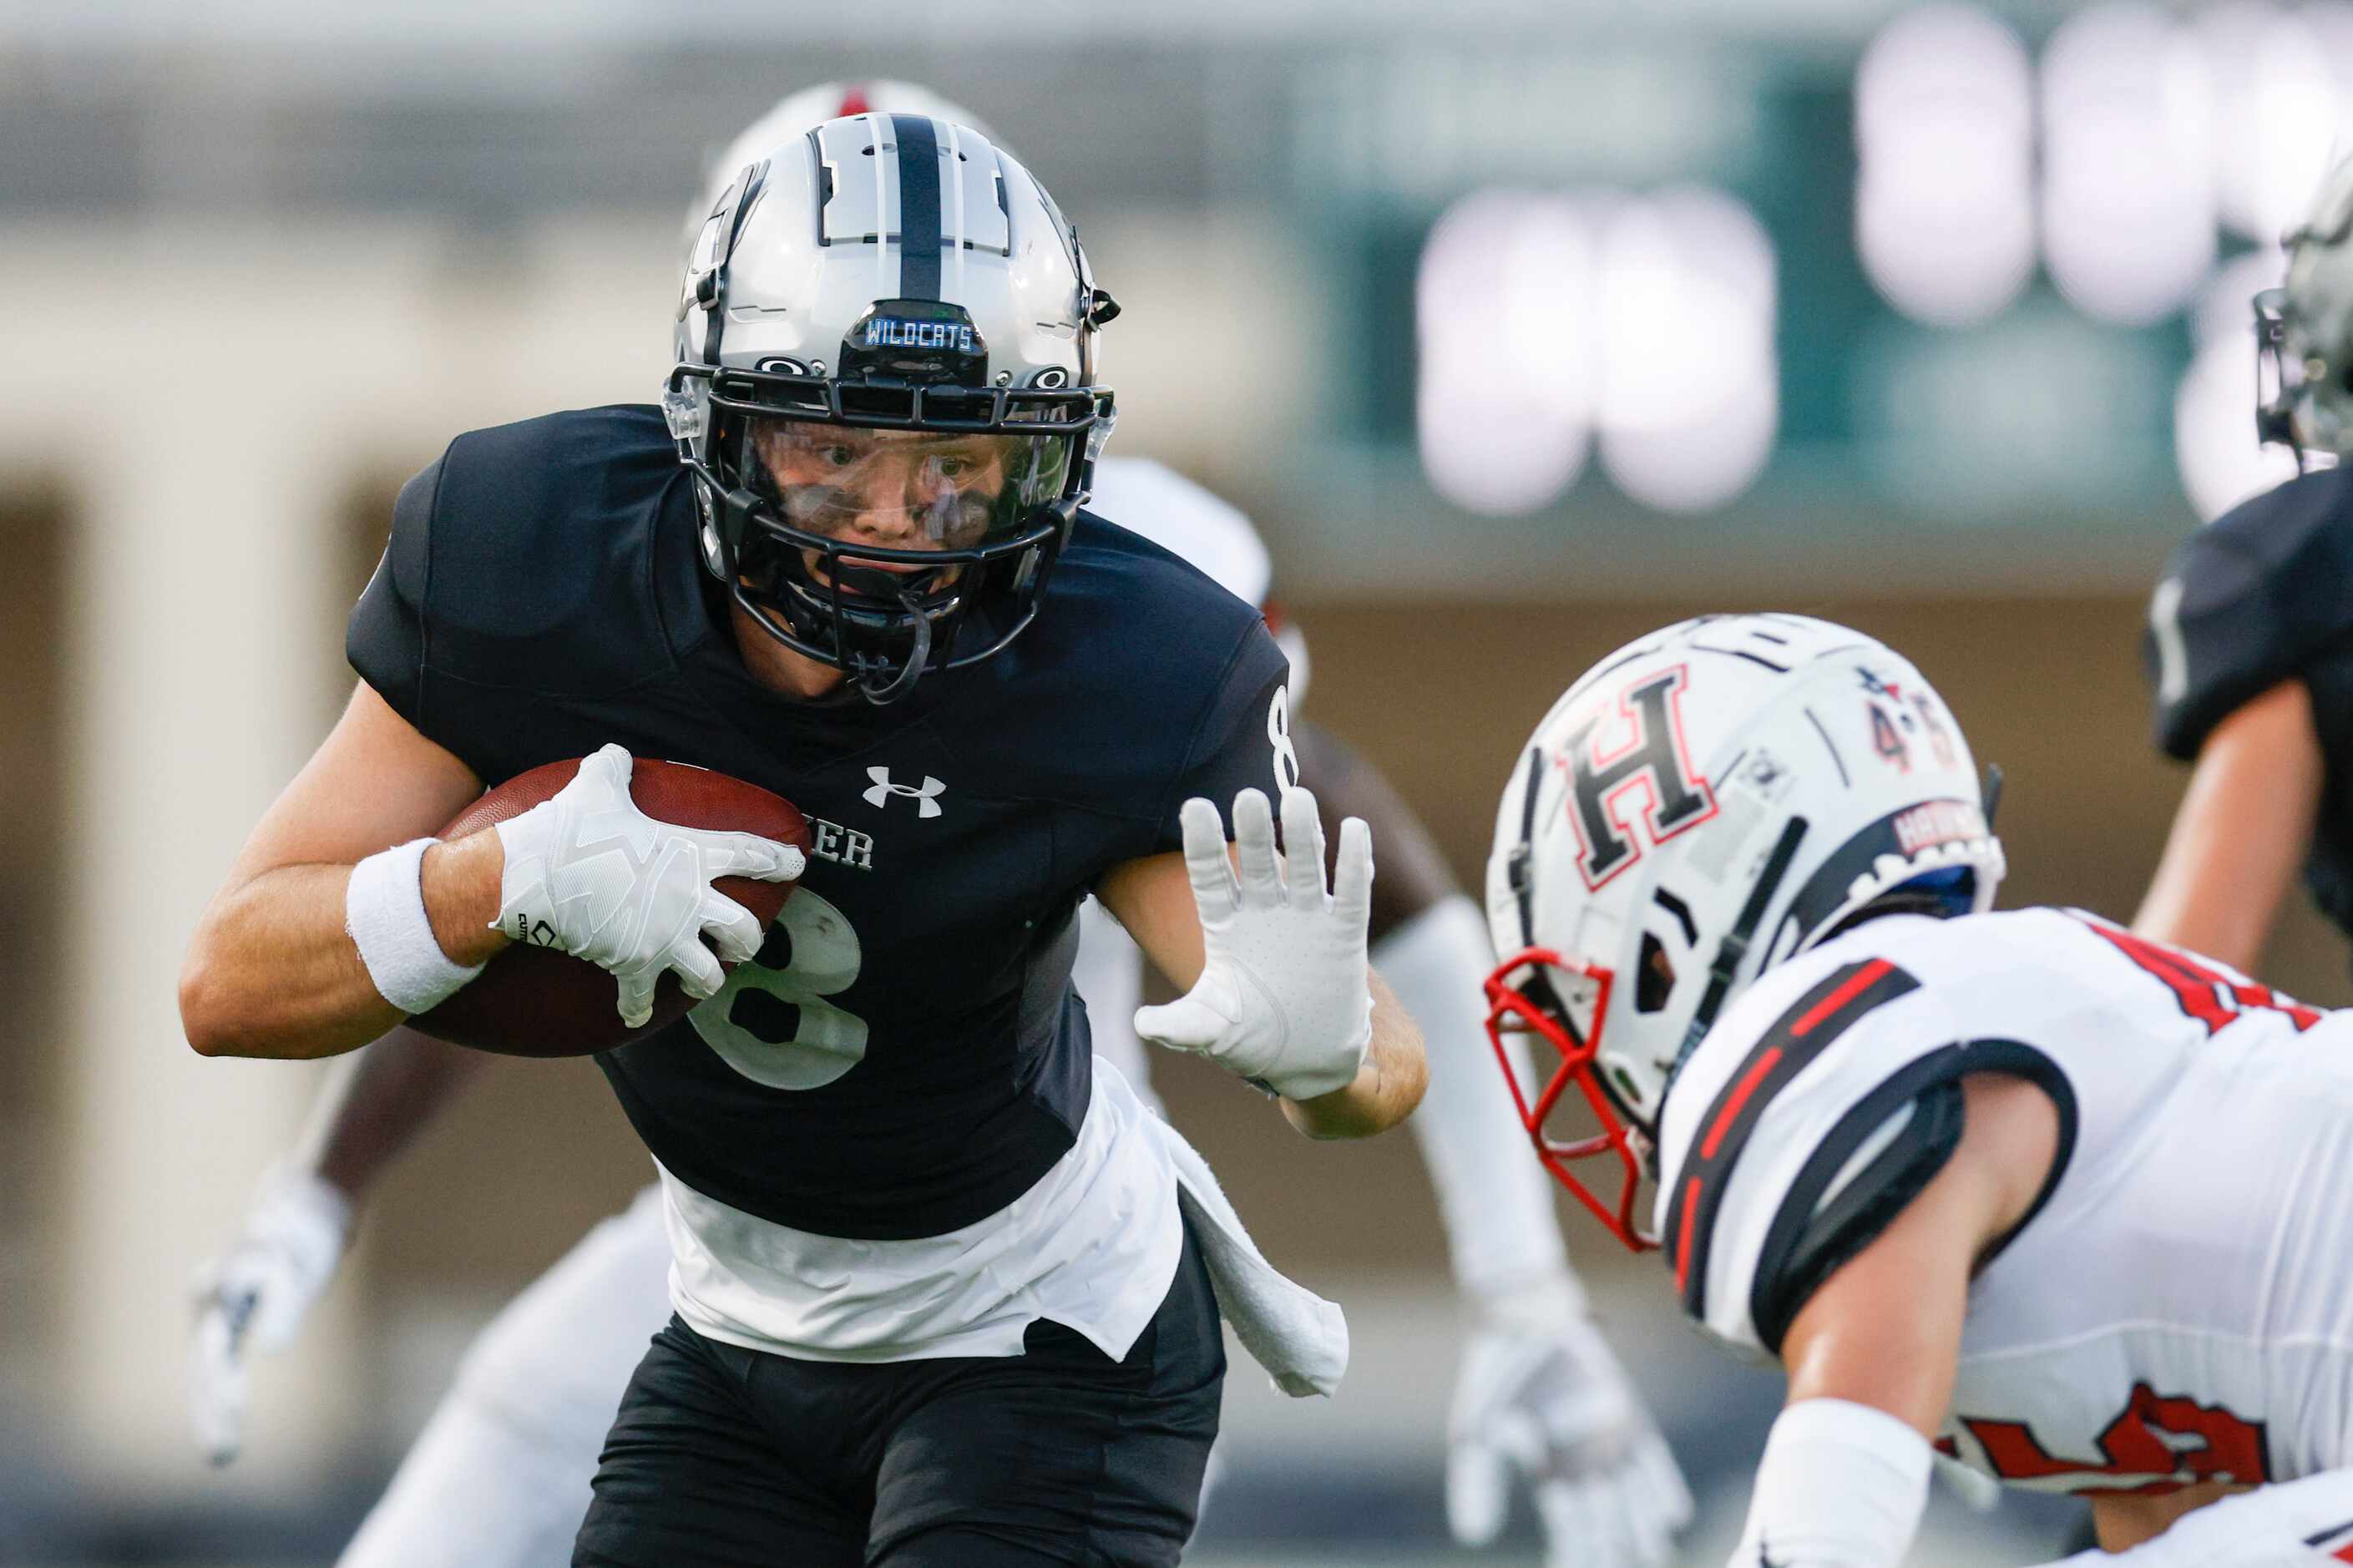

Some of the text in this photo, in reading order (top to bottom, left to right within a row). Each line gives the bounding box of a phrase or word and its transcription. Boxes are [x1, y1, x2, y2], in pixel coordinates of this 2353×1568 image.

[867, 319, 973, 352] WILDCATS
[1268, 685, 1299, 794] 8
[1553, 663, 1719, 893] H
[802, 812, 873, 872] ER
[686, 886, 868, 1090] 8
